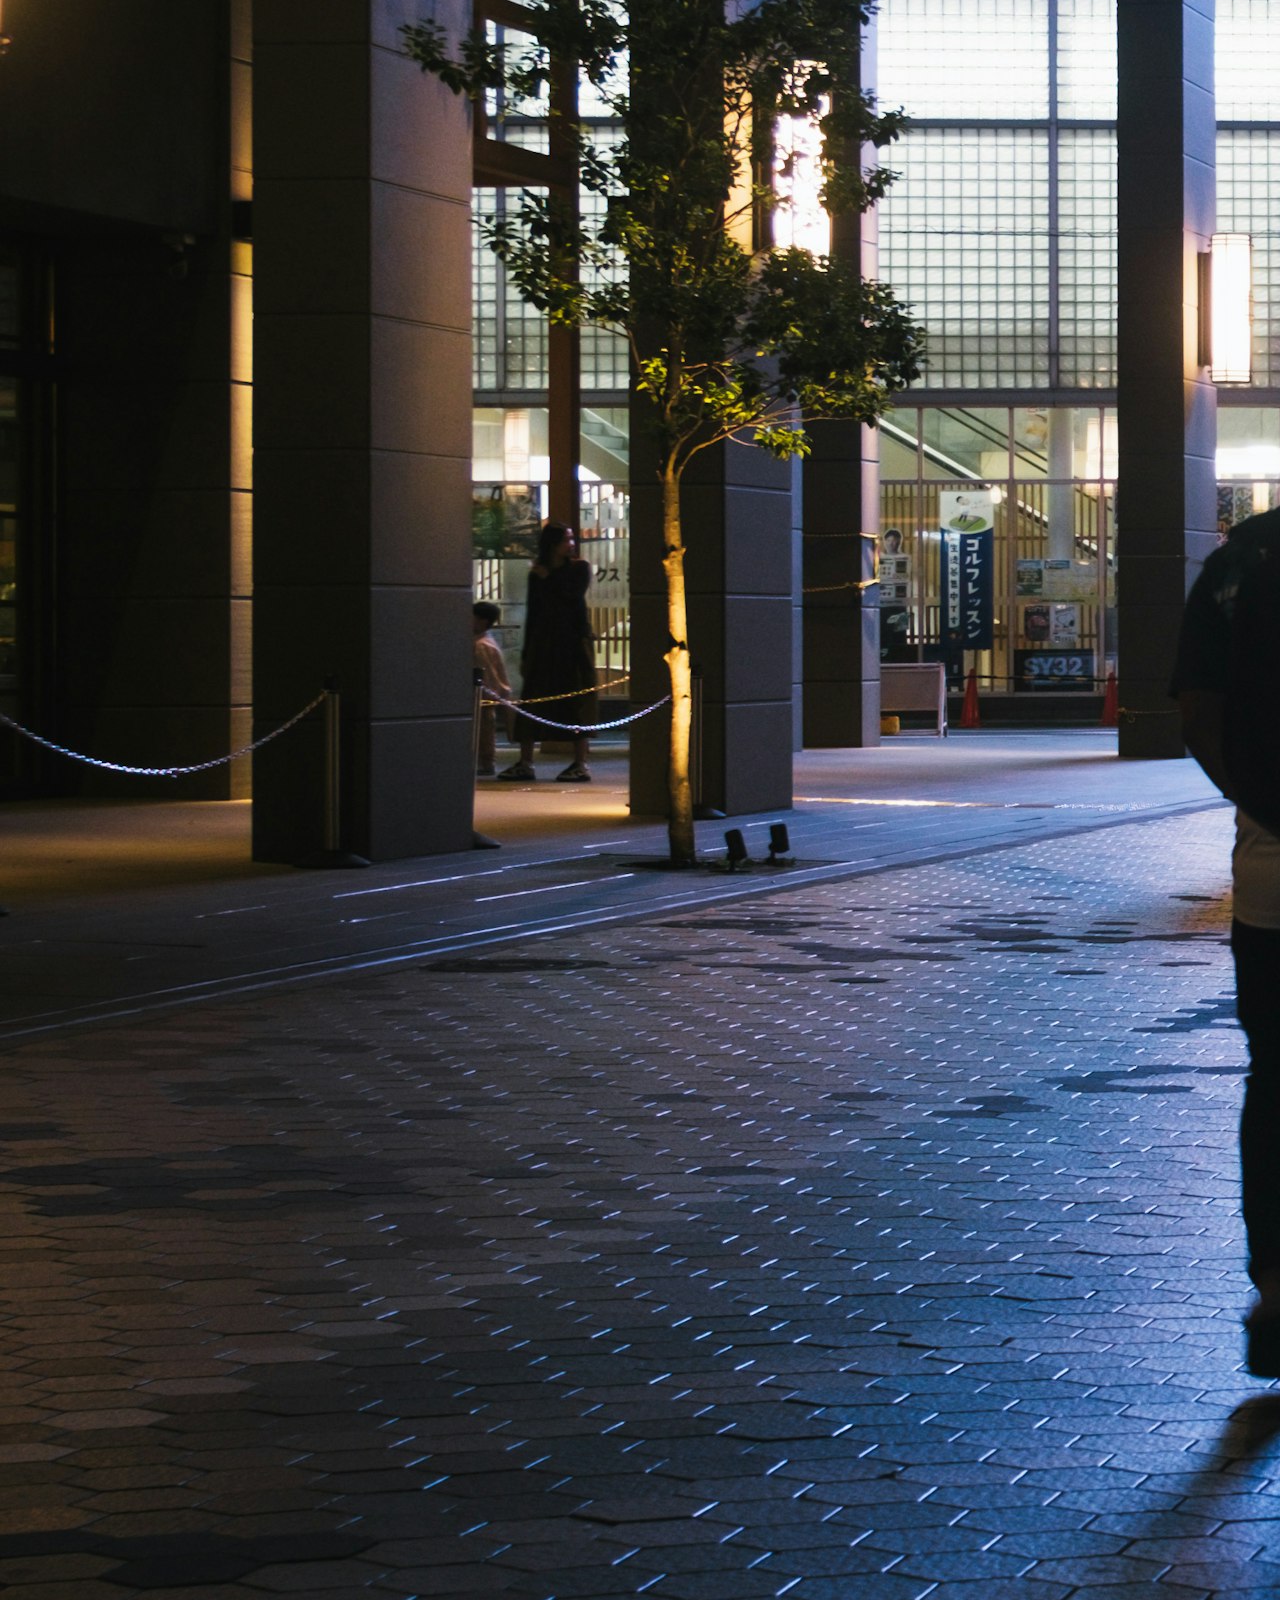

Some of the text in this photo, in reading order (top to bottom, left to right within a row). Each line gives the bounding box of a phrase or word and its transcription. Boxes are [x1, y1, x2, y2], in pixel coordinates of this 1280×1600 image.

[964, 535, 983, 639] ゴルフレッスン
[1023, 656, 1084, 676] SY32
